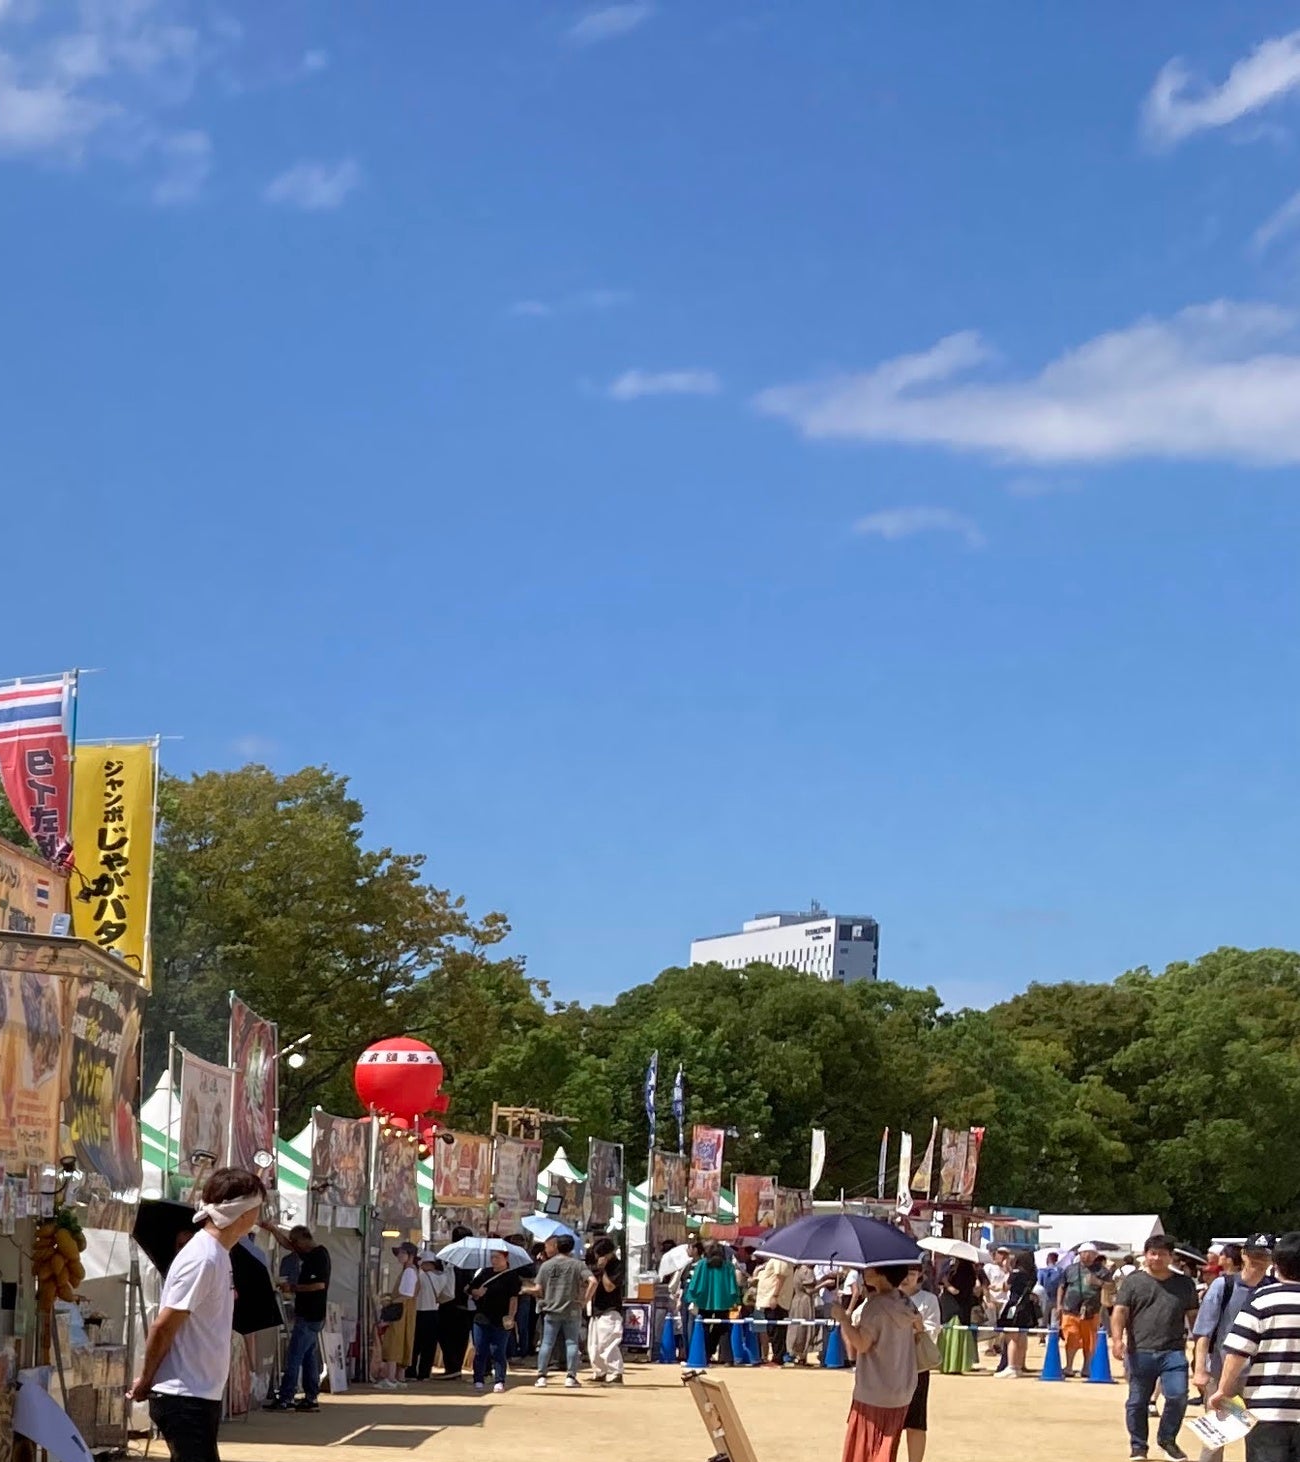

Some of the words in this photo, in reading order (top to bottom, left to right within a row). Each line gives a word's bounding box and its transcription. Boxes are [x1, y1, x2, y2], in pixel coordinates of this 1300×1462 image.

[92, 760, 129, 952] ジャンボじゃがバタ
